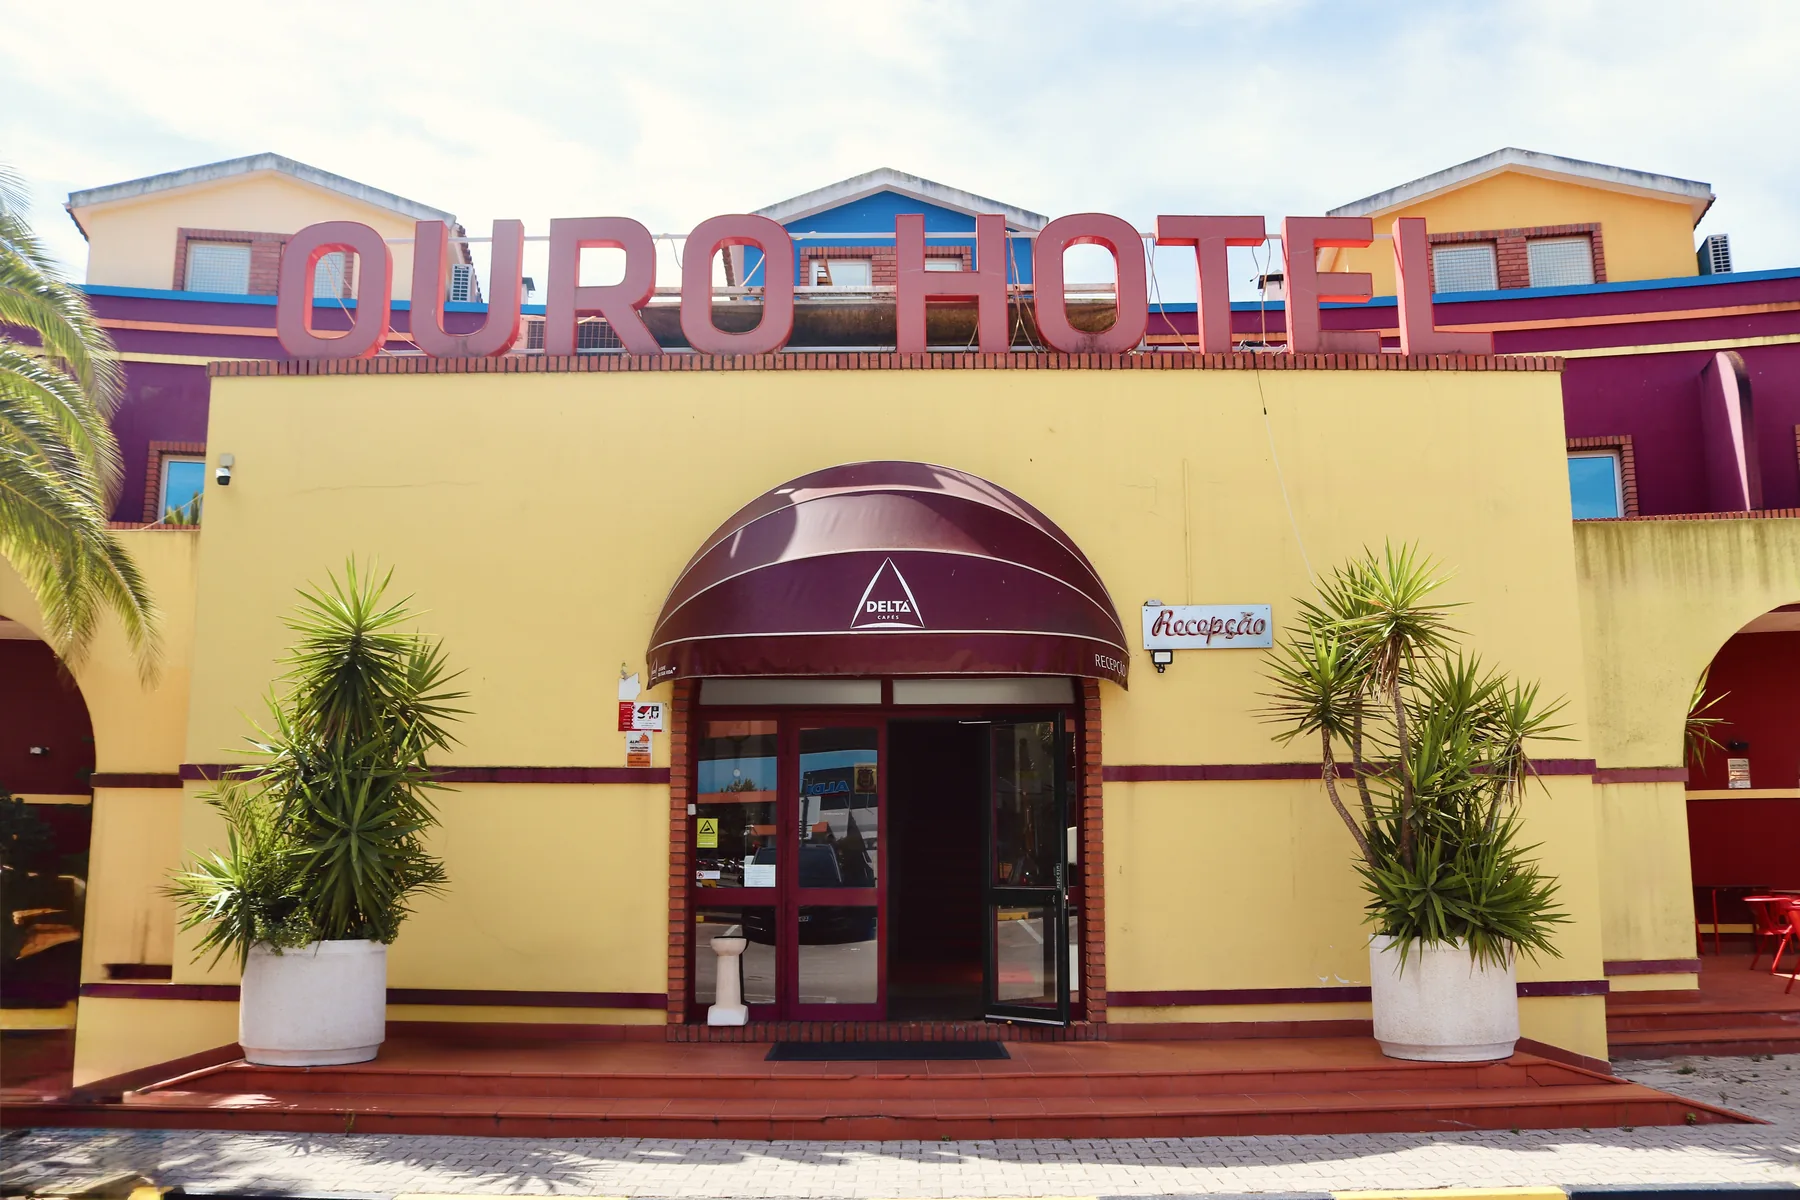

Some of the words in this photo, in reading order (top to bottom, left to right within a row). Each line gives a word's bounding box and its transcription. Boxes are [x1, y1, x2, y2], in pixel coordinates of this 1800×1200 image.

[276, 213, 795, 358] OURO
[895, 212, 1495, 357] HOTEL
[866, 600, 912, 613] DELTA
[1151, 609, 1266, 645] Recepção
